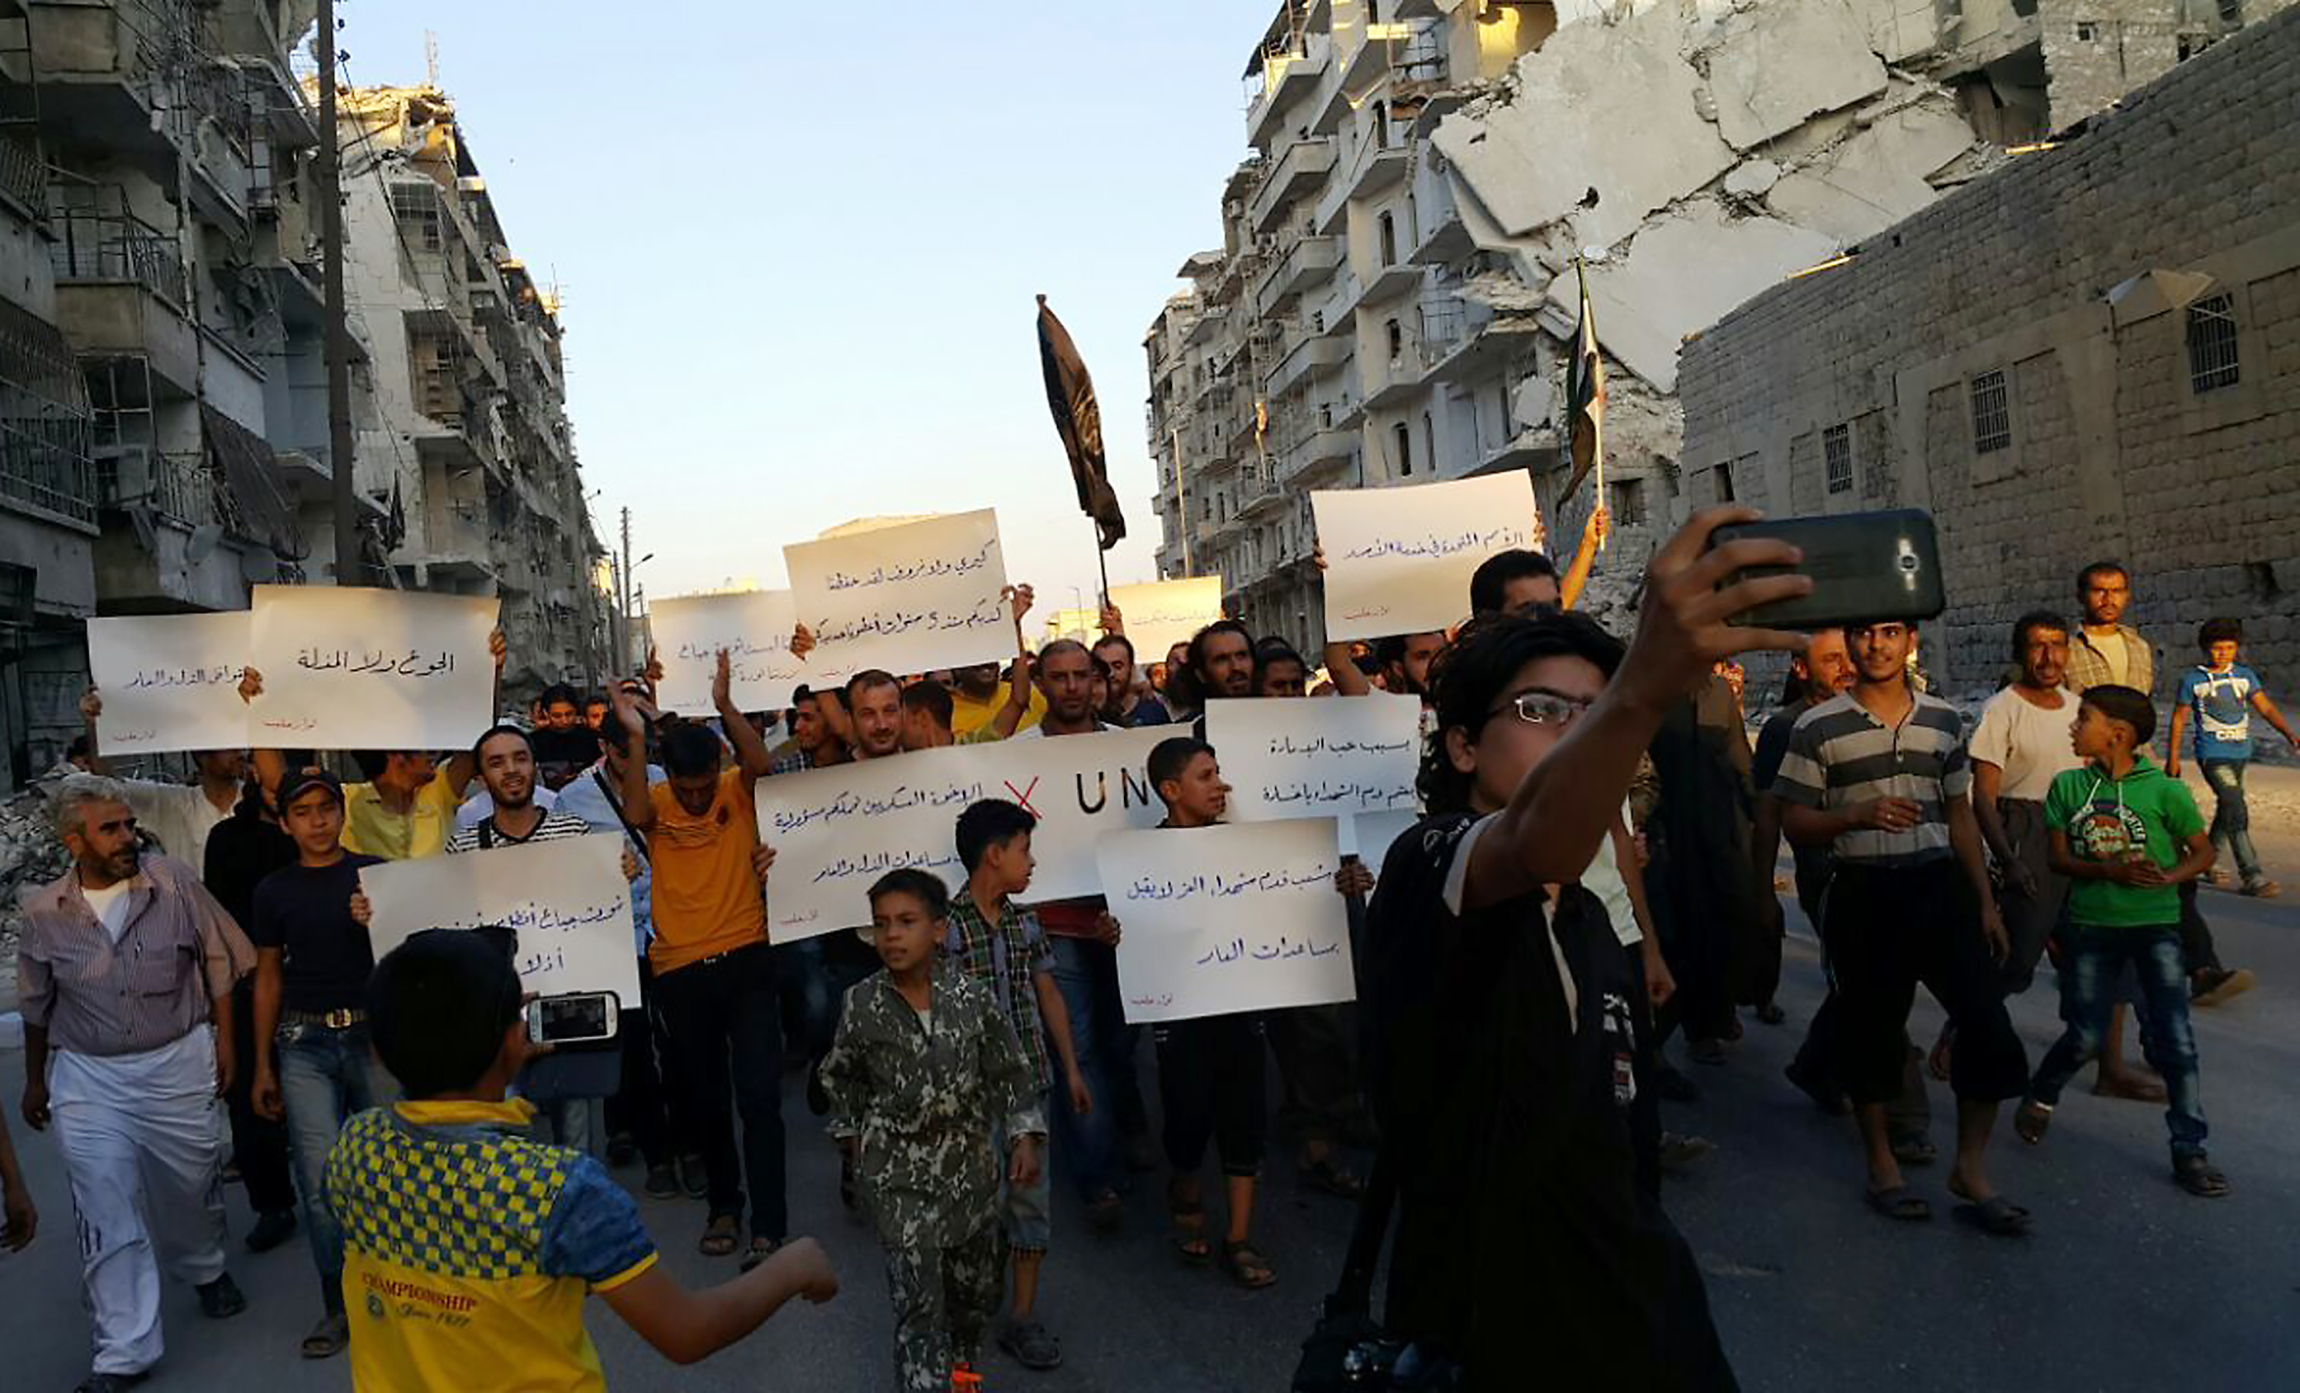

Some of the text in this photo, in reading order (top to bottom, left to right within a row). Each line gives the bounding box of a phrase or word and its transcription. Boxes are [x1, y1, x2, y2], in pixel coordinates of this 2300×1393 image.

[297, 646, 455, 677] الجوع ولا المذلة
[1328, 740, 1357, 759] حب
[1076, 767, 1149, 815] UN
[519, 946, 565, 976] أذلا
[1196, 937, 1246, 965] العار
